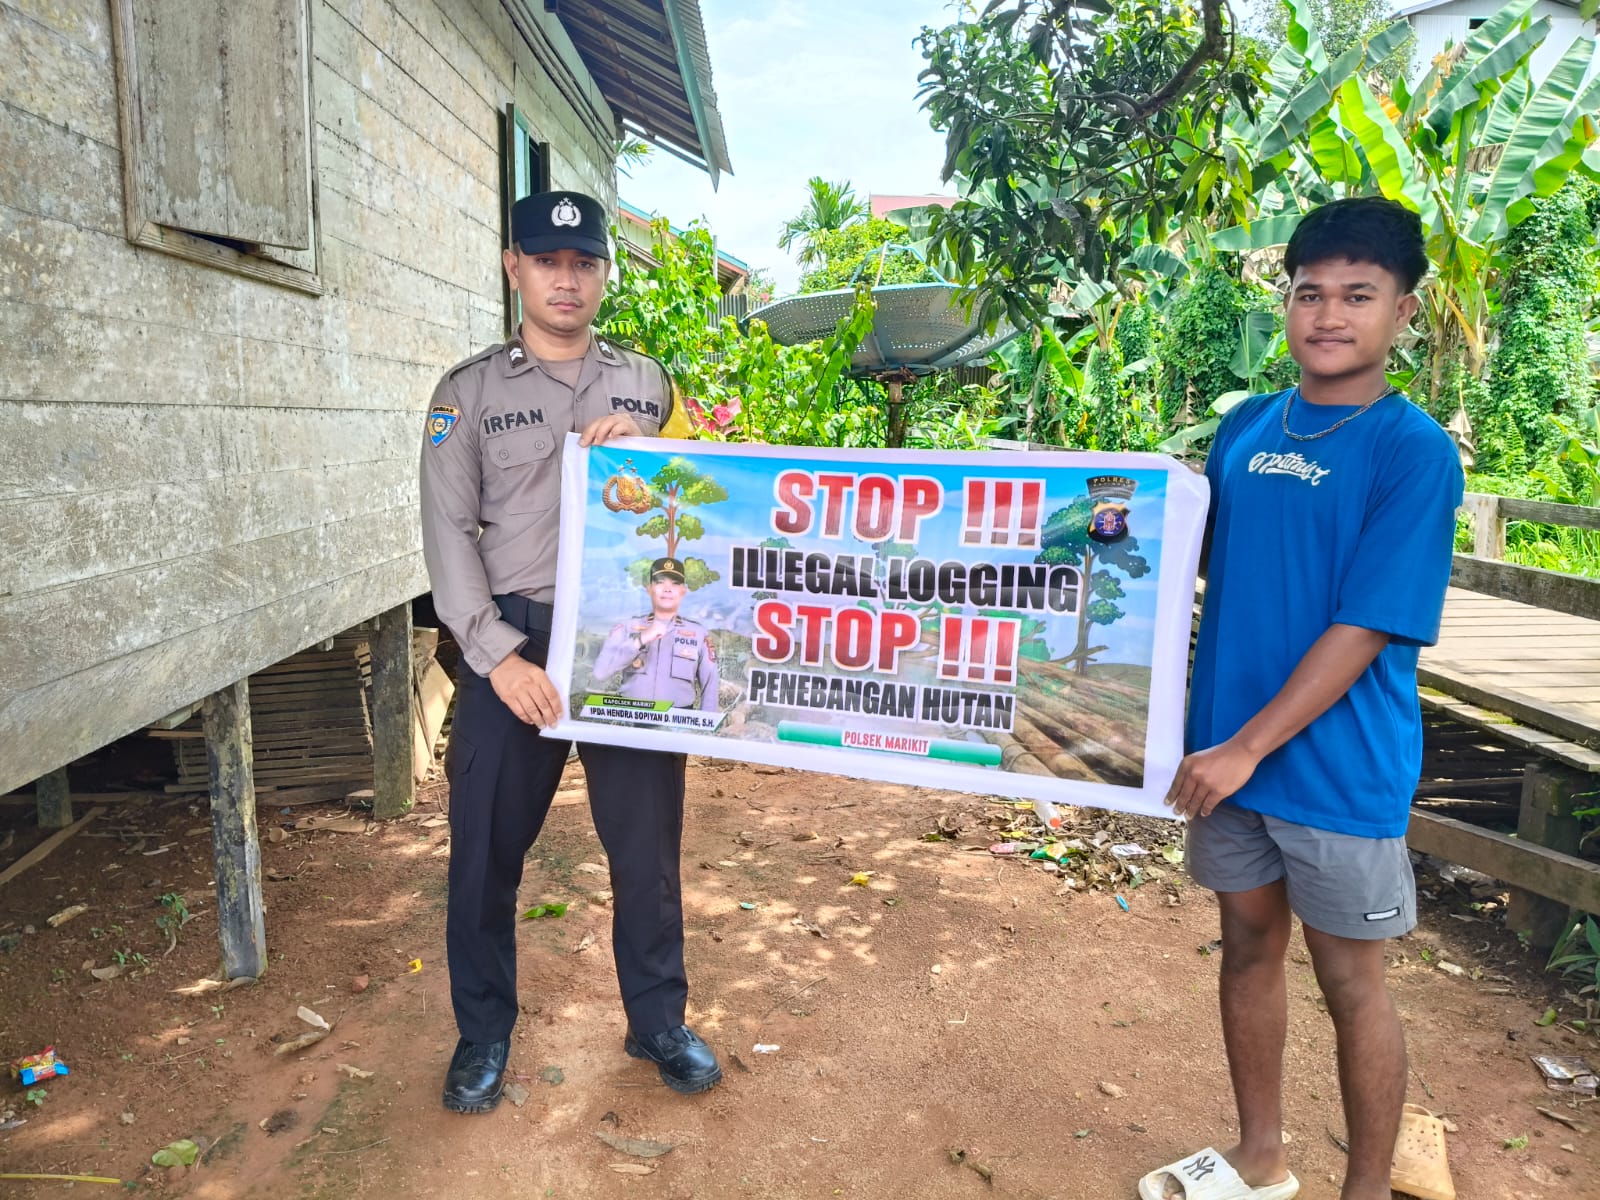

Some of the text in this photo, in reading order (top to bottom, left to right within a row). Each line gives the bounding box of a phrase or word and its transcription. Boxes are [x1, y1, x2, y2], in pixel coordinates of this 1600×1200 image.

[610, 396, 659, 418] POLRI
[483, 408, 545, 434] IRFAN
[1093, 477, 1131, 485] POLRES
[773, 471, 943, 544] STOP
[731, 547, 1080, 612] ILLEGAL LOGGING
[674, 637, 698, 646] POLRI
[755, 602, 918, 672] STOP
[750, 670, 1014, 730] PENEBANGAN HUTAN
[590, 707, 715, 728] IPDA HENDRA SOPIYAN D. MUNTHE, S.H.
[843, 731, 929, 753] POLSEK MARIKIT
